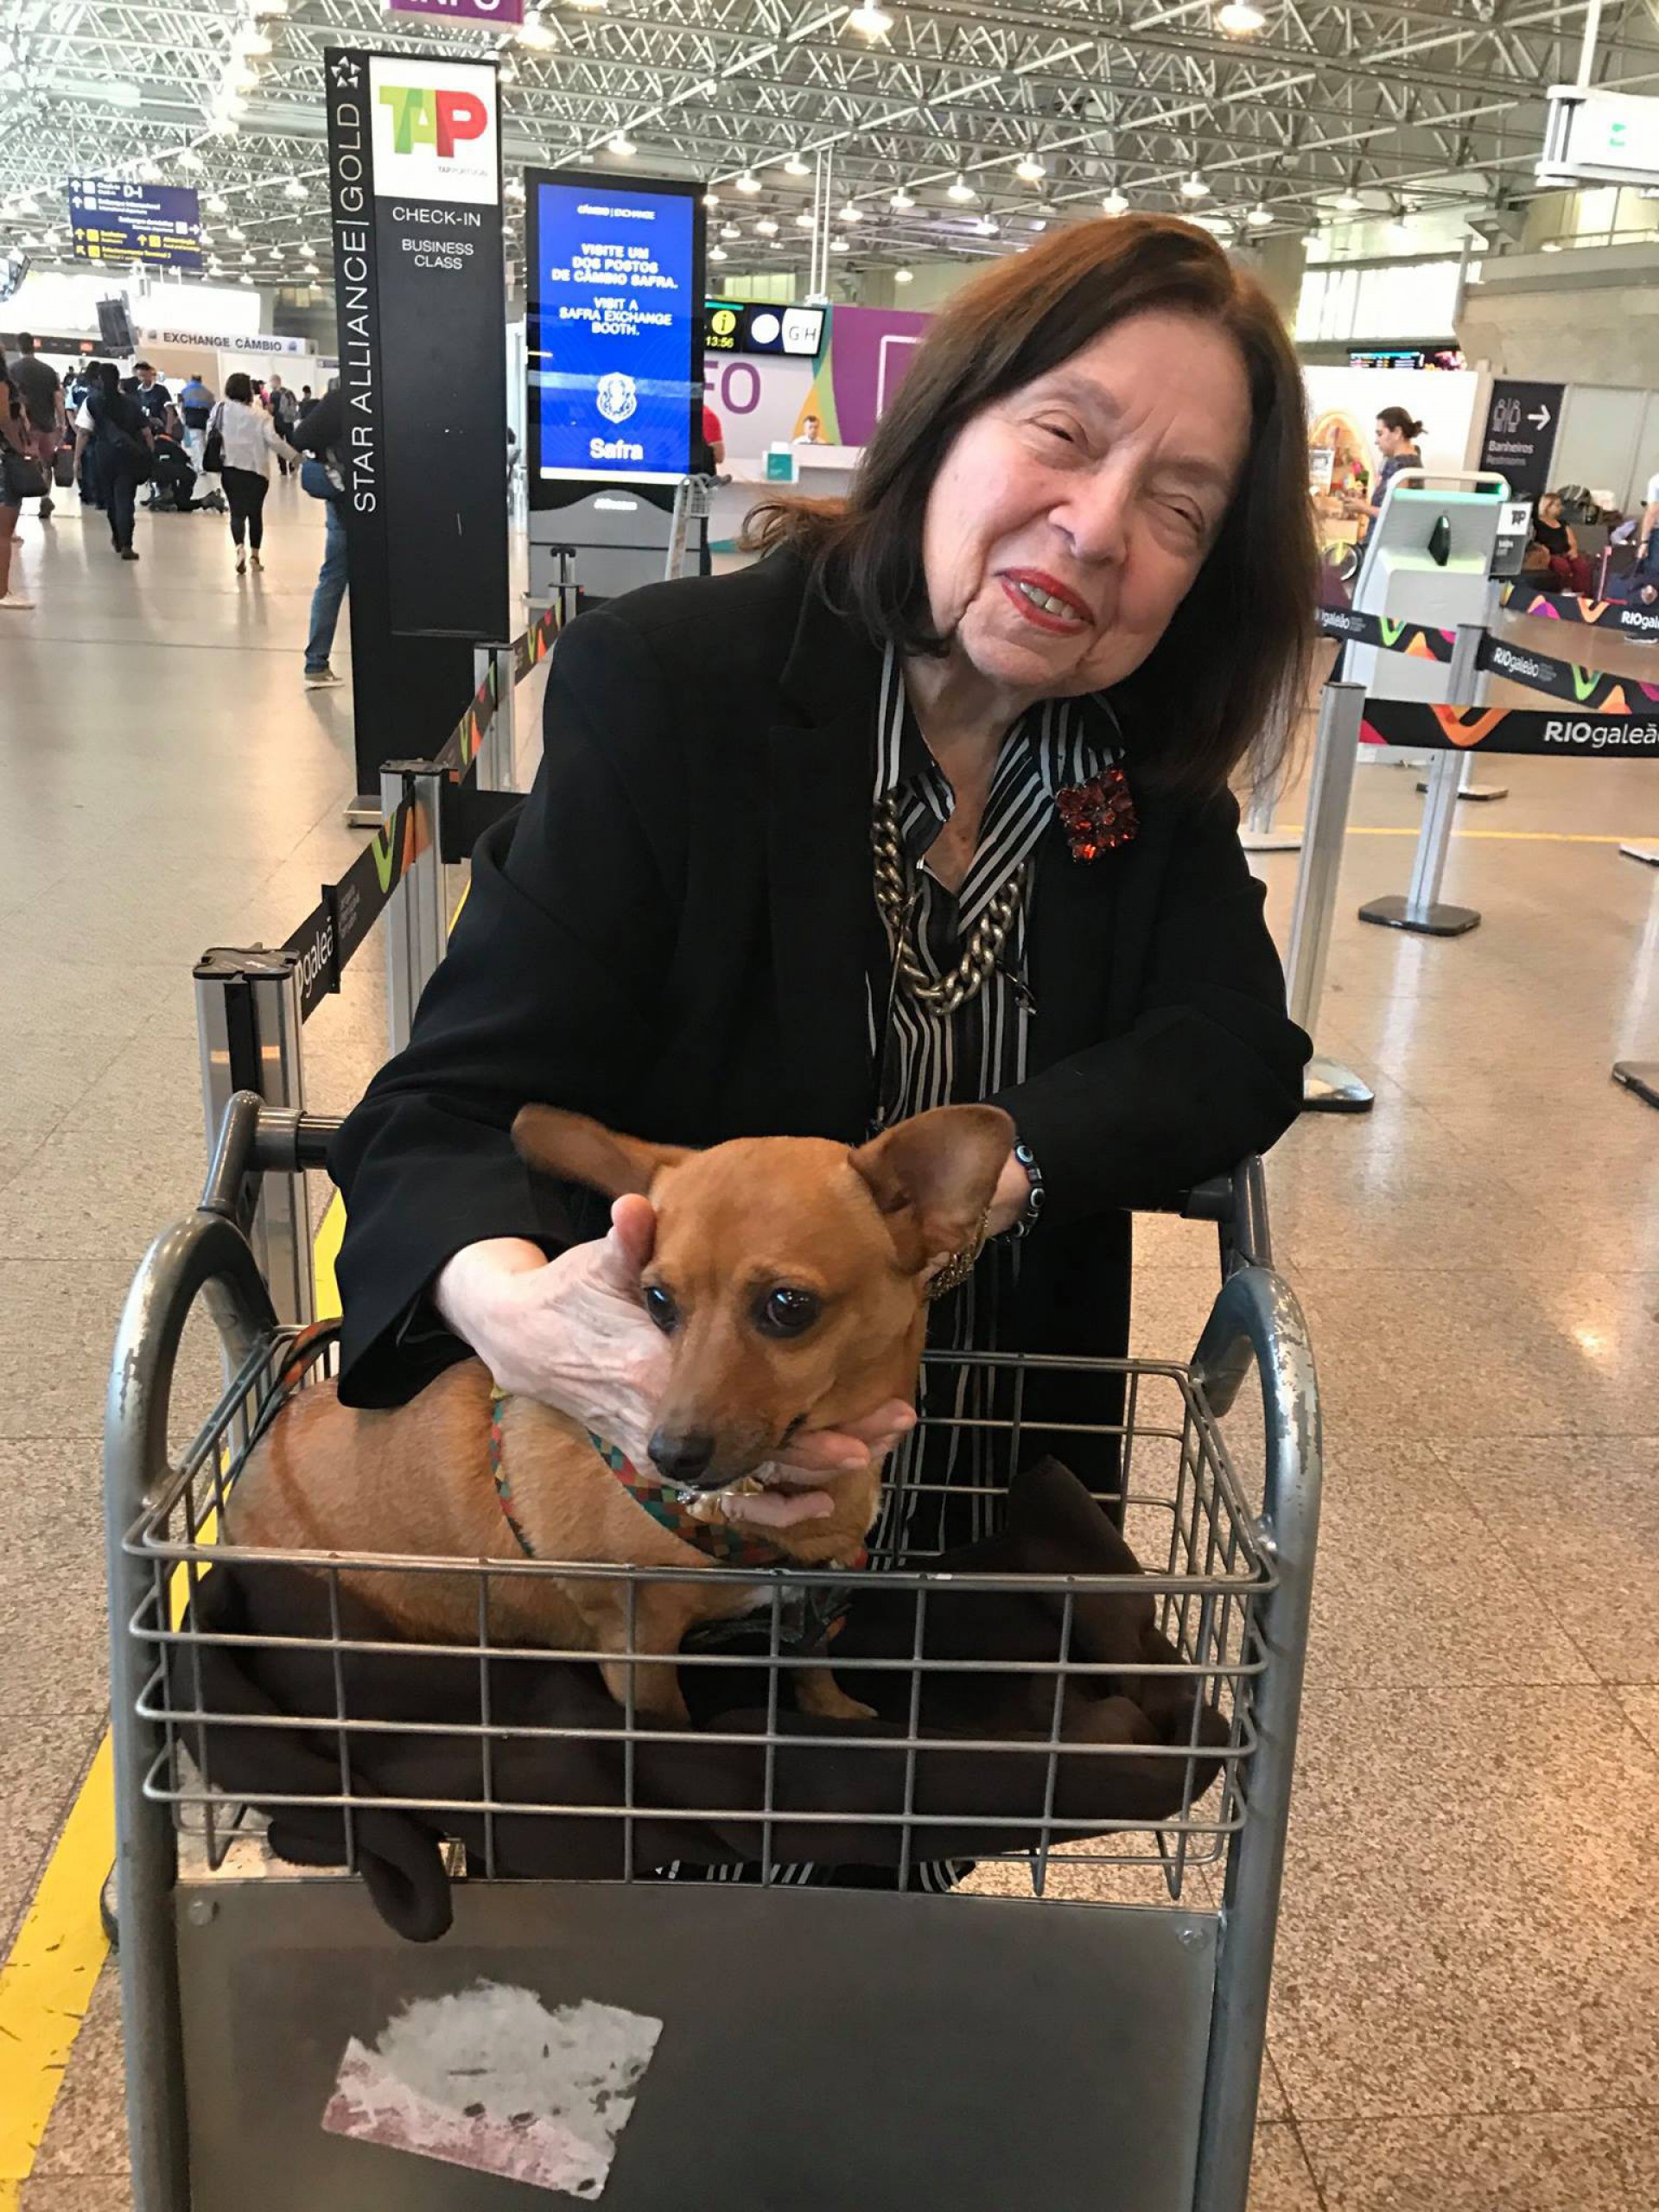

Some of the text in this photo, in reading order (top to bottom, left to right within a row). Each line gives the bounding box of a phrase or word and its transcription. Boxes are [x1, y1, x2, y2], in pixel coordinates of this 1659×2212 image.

[379, 86, 488, 158] TAP
[392, 207, 481, 227] CHECK-IN
[402, 238, 474, 256] BUSINESS
[581, 243, 625, 258] VISITE
[414, 255, 463, 270] CLASS
[336, 103, 376, 513] STAR ALLIANCE GOLD
[628, 299, 639, 311] A
[559, 306, 674, 327] SAFRA EXCHANGE
[164, 332, 283, 352] EXCHANGE CÂMBIO
[590, 437, 644, 461] Safra
[1488, 440, 1535, 454] Banheiros
[1621, 611, 1659, 631] RIOgal
[1544, 721, 1659, 748] RIOgaleã
